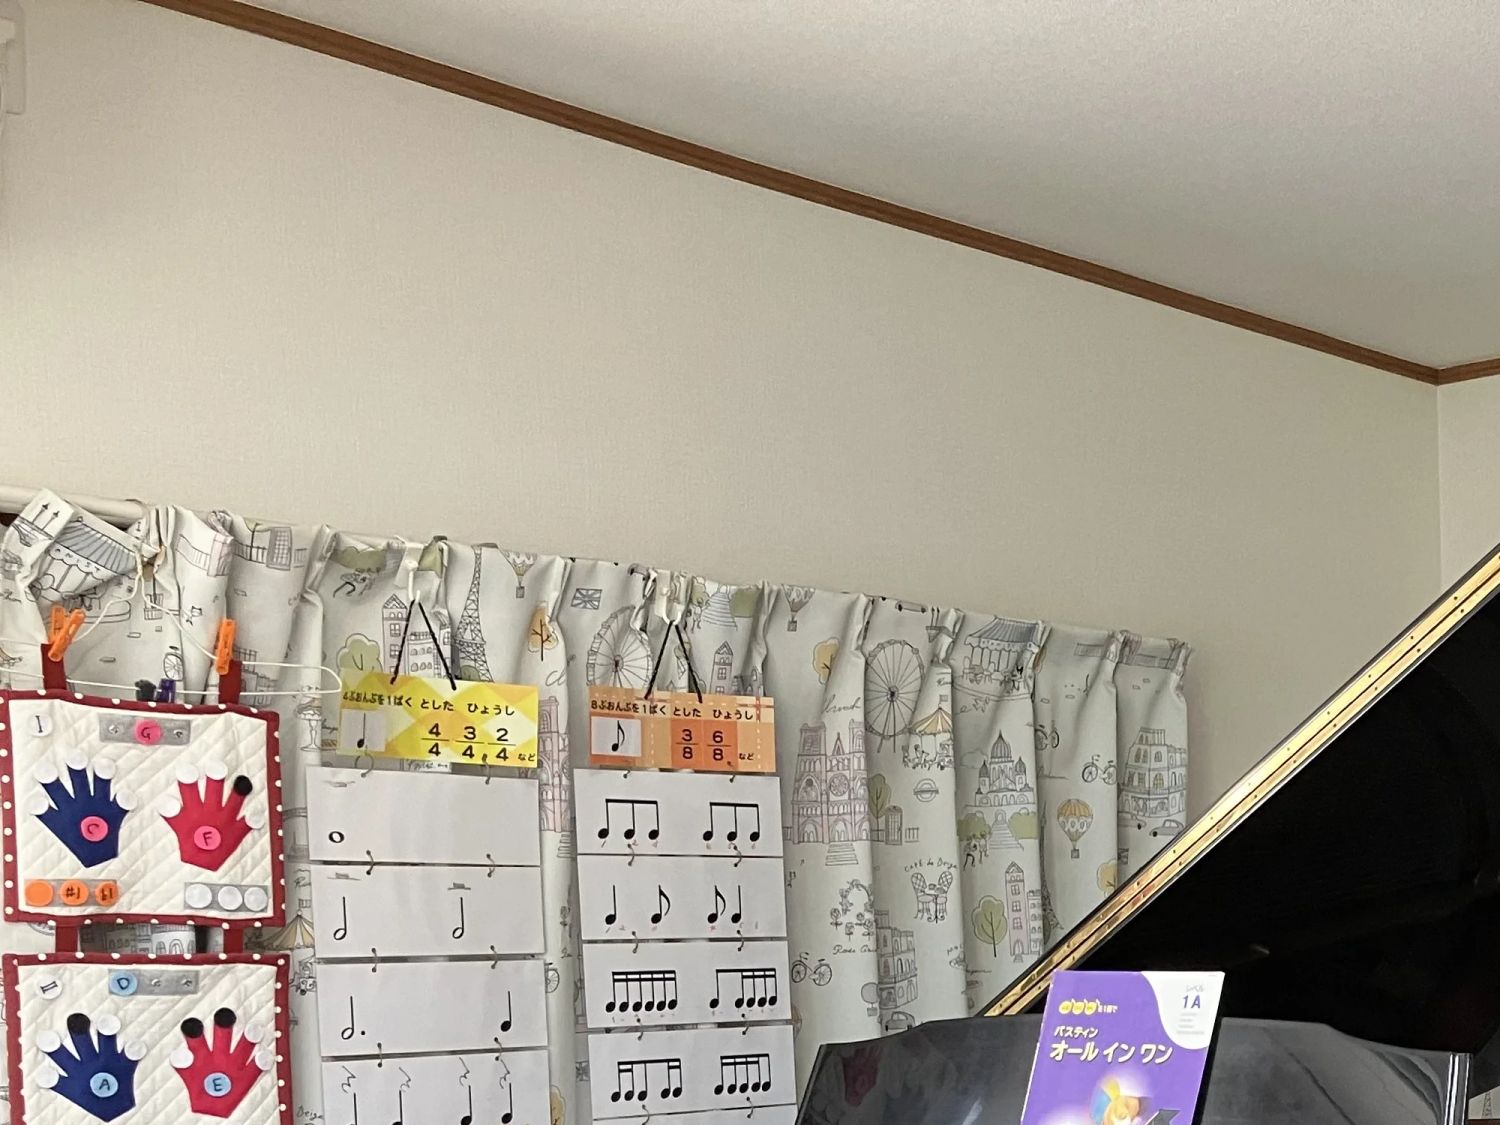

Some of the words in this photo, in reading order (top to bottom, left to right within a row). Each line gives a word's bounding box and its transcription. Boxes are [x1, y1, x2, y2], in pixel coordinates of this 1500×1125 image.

[420, 700, 455, 712] とした
[467, 702, 515, 716] ひょうし
[673, 706, 702, 718] とした
[712, 708, 754, 720] ひょうし
[428, 723, 441, 737] 4
[463, 726, 477, 740] 3
[496, 728, 509, 742] 2
[681, 728, 693, 742] 3
[712, 730, 724, 744] 6
[428, 742, 441, 757] 4
[462, 744, 475, 759] 4
[496, 747, 509, 762] 4
[518, 753, 536, 762] など
[682, 746, 694, 760] 8
[712, 747, 724, 761] 8
[739, 753, 754, 761] など
[203, 831, 213, 847] F
[116, 977, 130, 990] D
[1050, 1040, 1100, 1062] オール
[1103, 1042, 1136, 1063] イン
[1140, 1043, 1174, 1065] ワン
[98, 1078, 111, 1091] A
[212, 1078, 223, 1092] E
